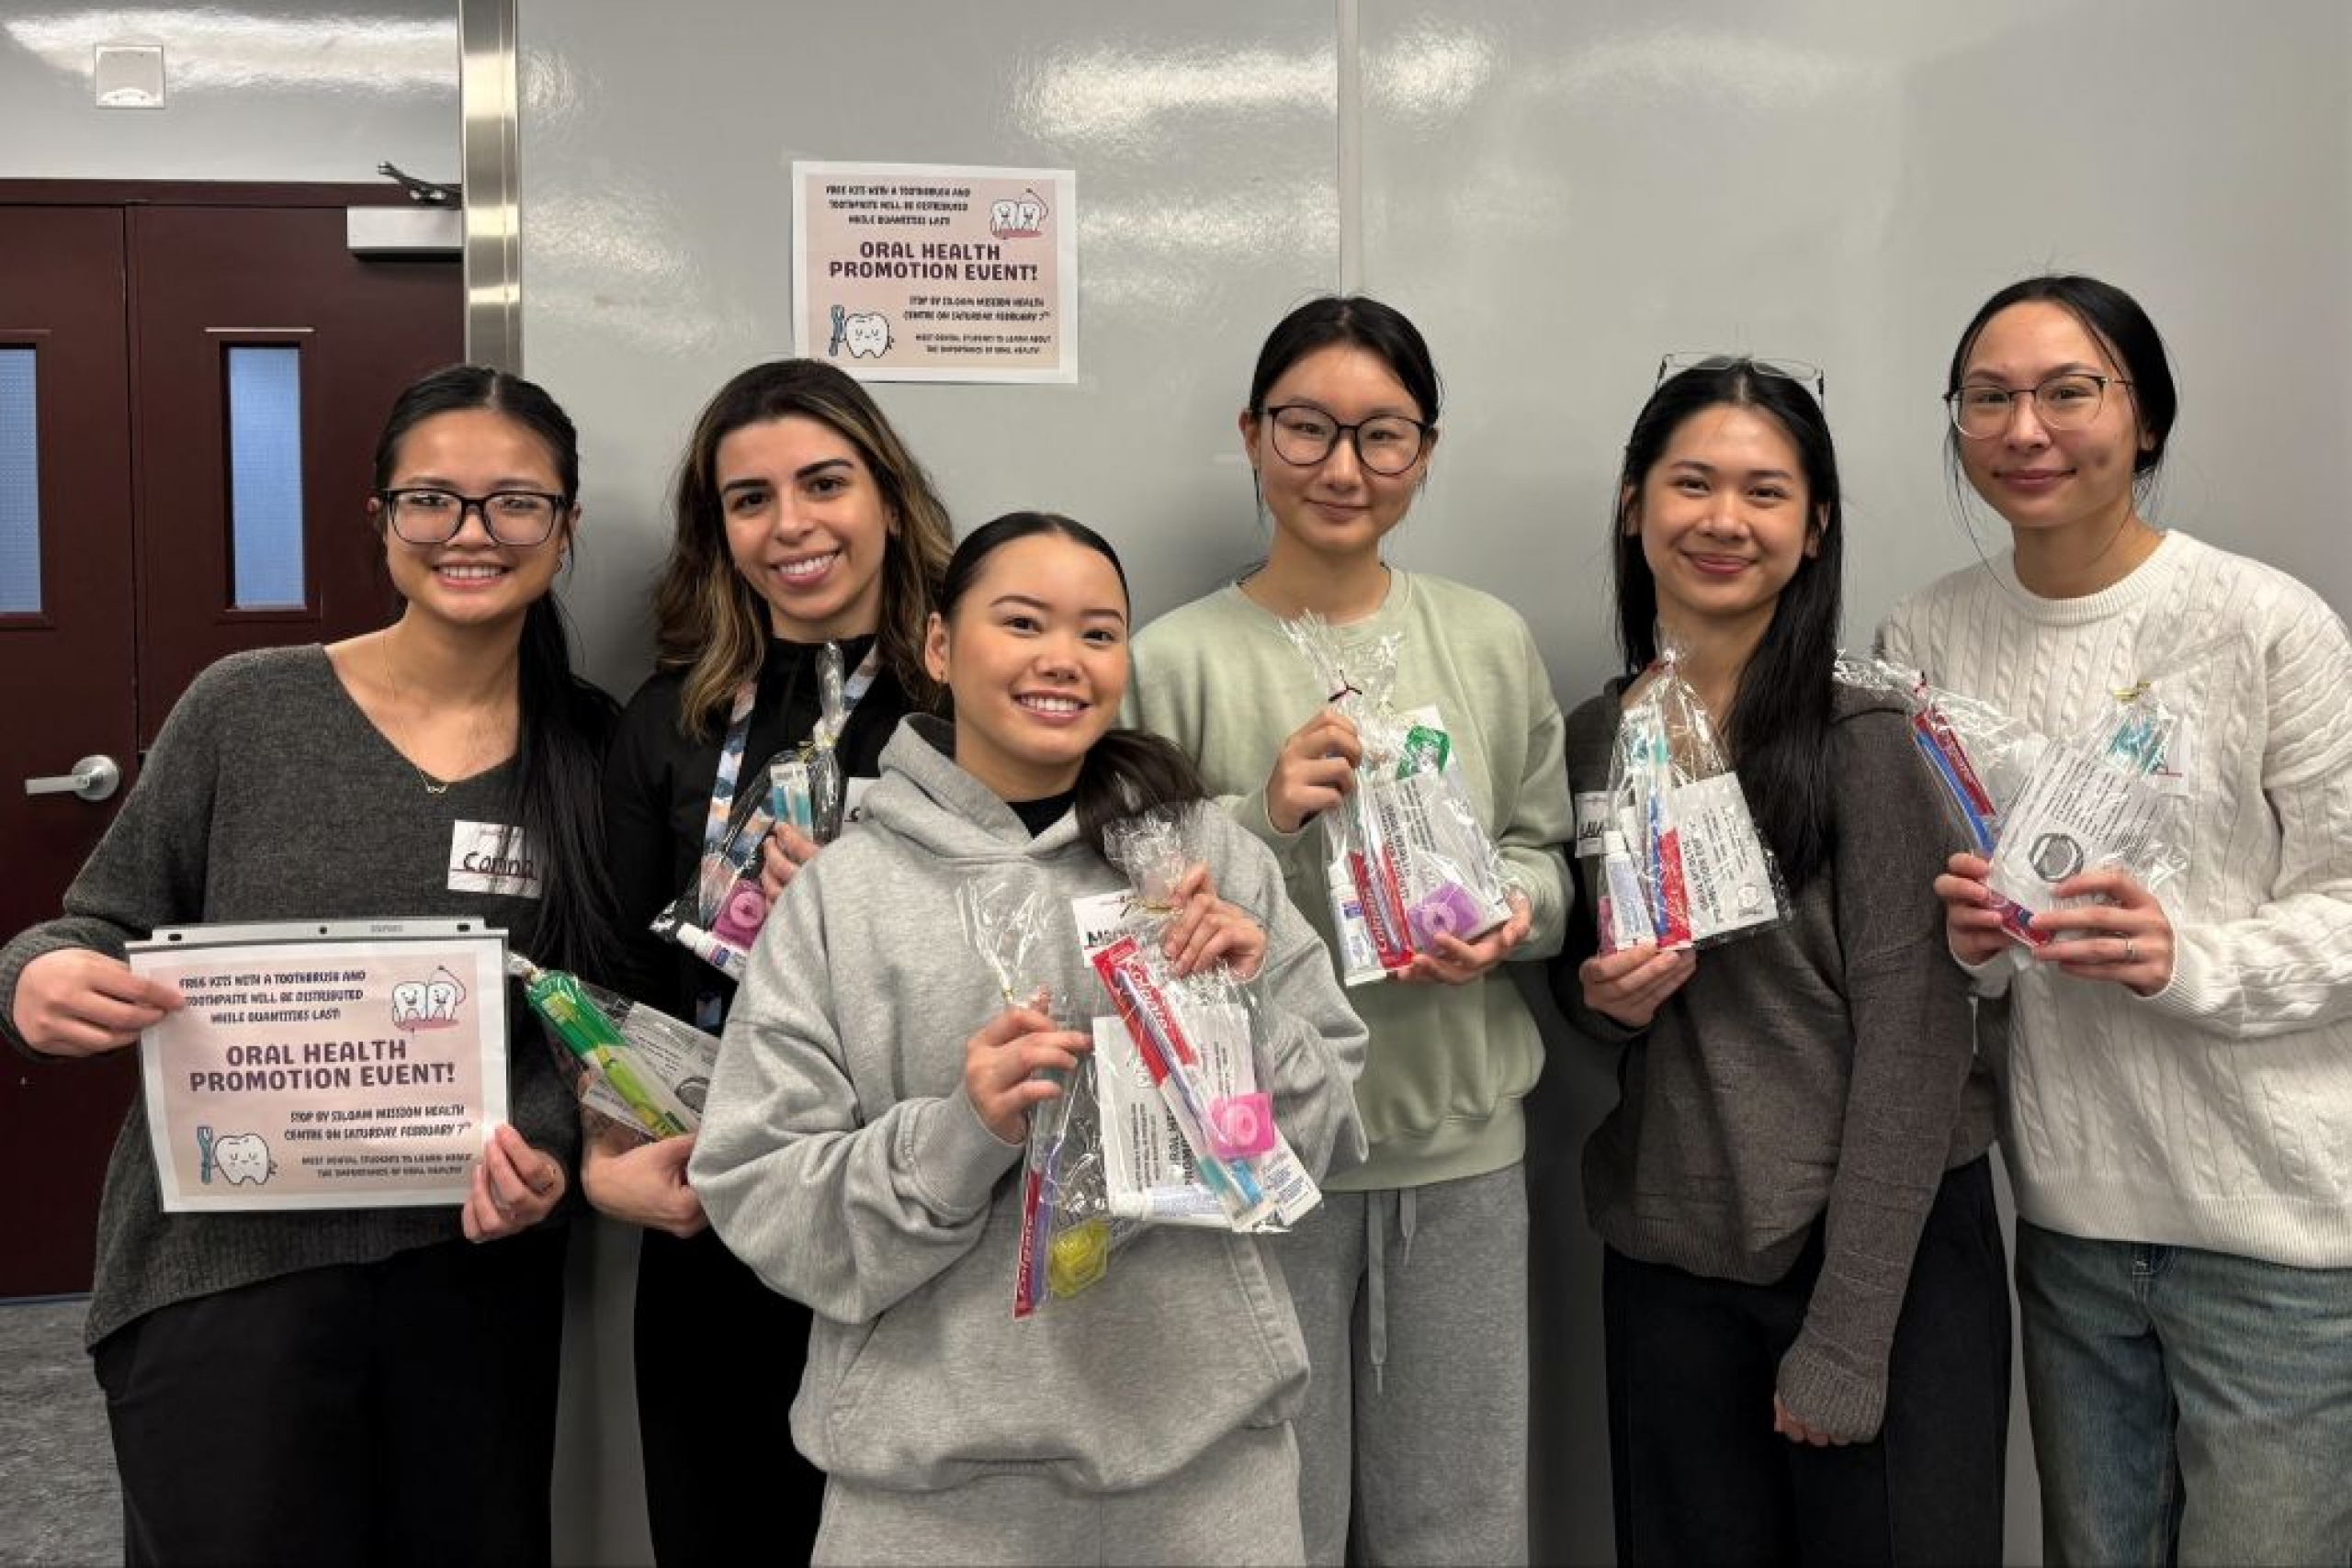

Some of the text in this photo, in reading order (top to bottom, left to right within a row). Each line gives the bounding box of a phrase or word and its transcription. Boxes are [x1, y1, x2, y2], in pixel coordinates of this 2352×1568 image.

[860, 242, 1000, 259] ORAL HEALTH
[830, 261, 1038, 281] PROMOTION EVENT!
[226, 1040, 407, 1066] ORAL HEALTH
[189, 1065, 455, 1091] PROMOTION EVENT!
